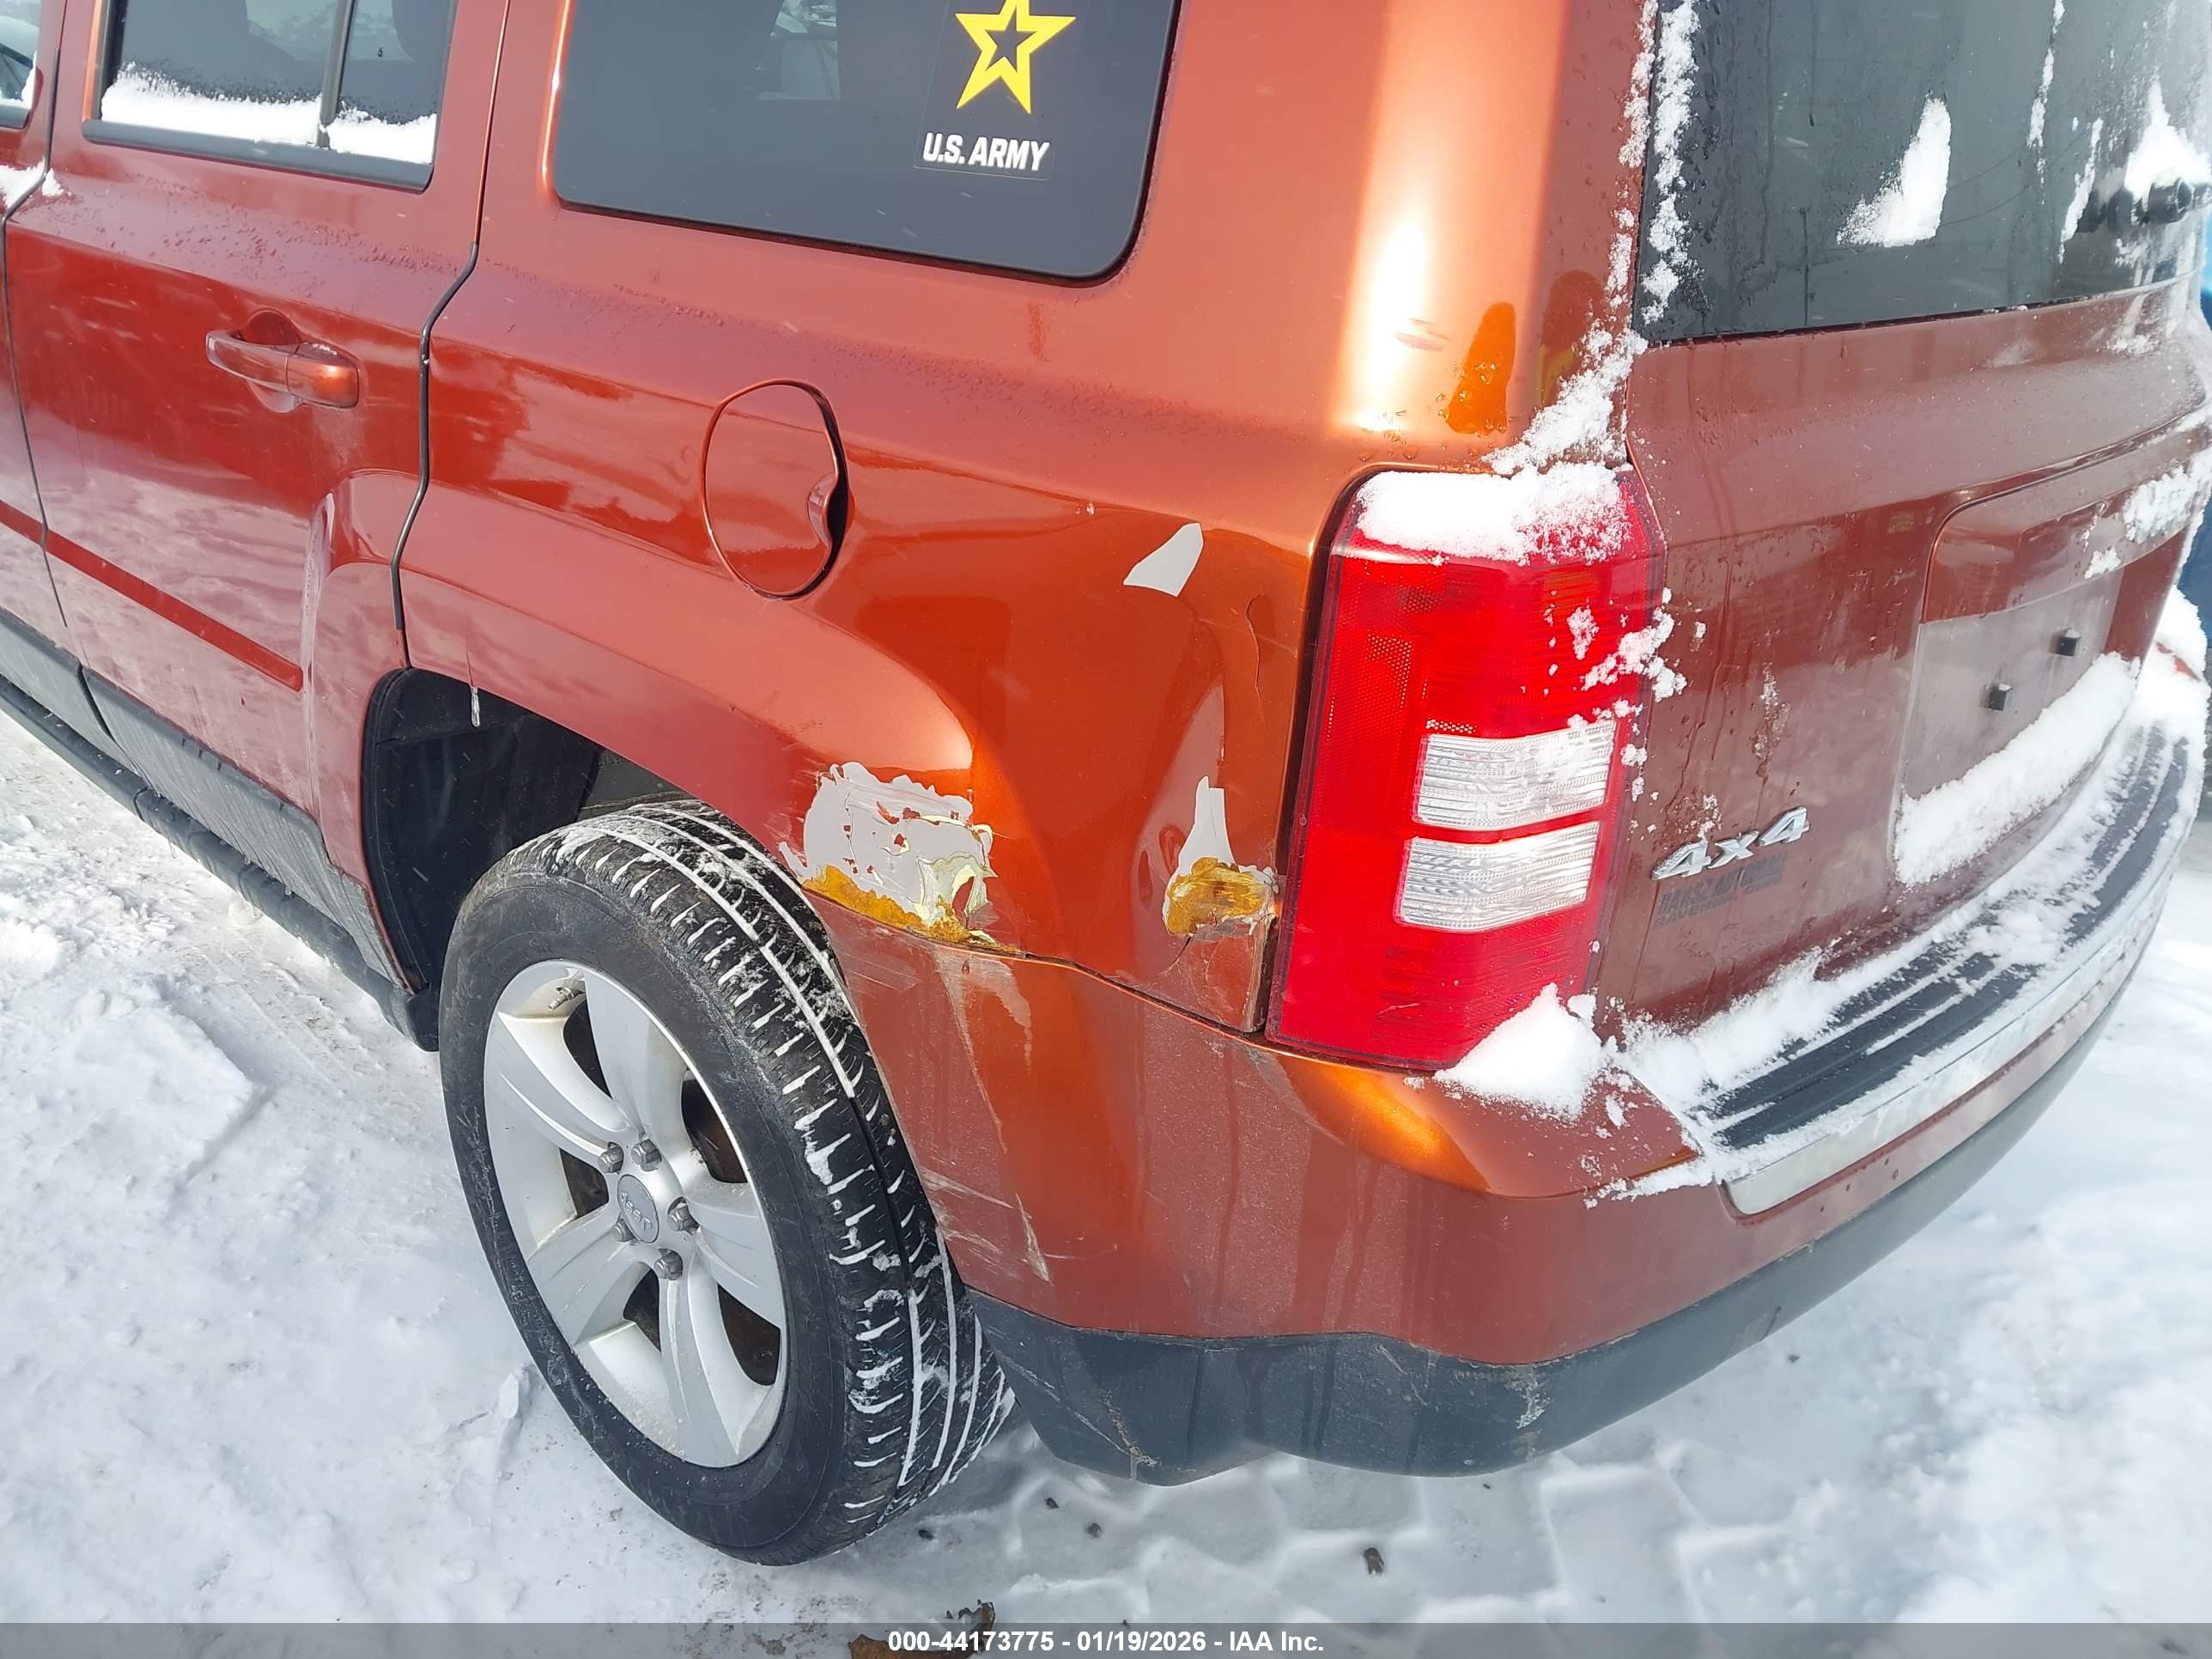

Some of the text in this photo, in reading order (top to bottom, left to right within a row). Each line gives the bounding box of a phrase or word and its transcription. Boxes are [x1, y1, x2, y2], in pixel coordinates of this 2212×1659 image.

[923, 132, 1050, 171] U.S. ARMY
[1650, 806, 1809, 880] 4x4
